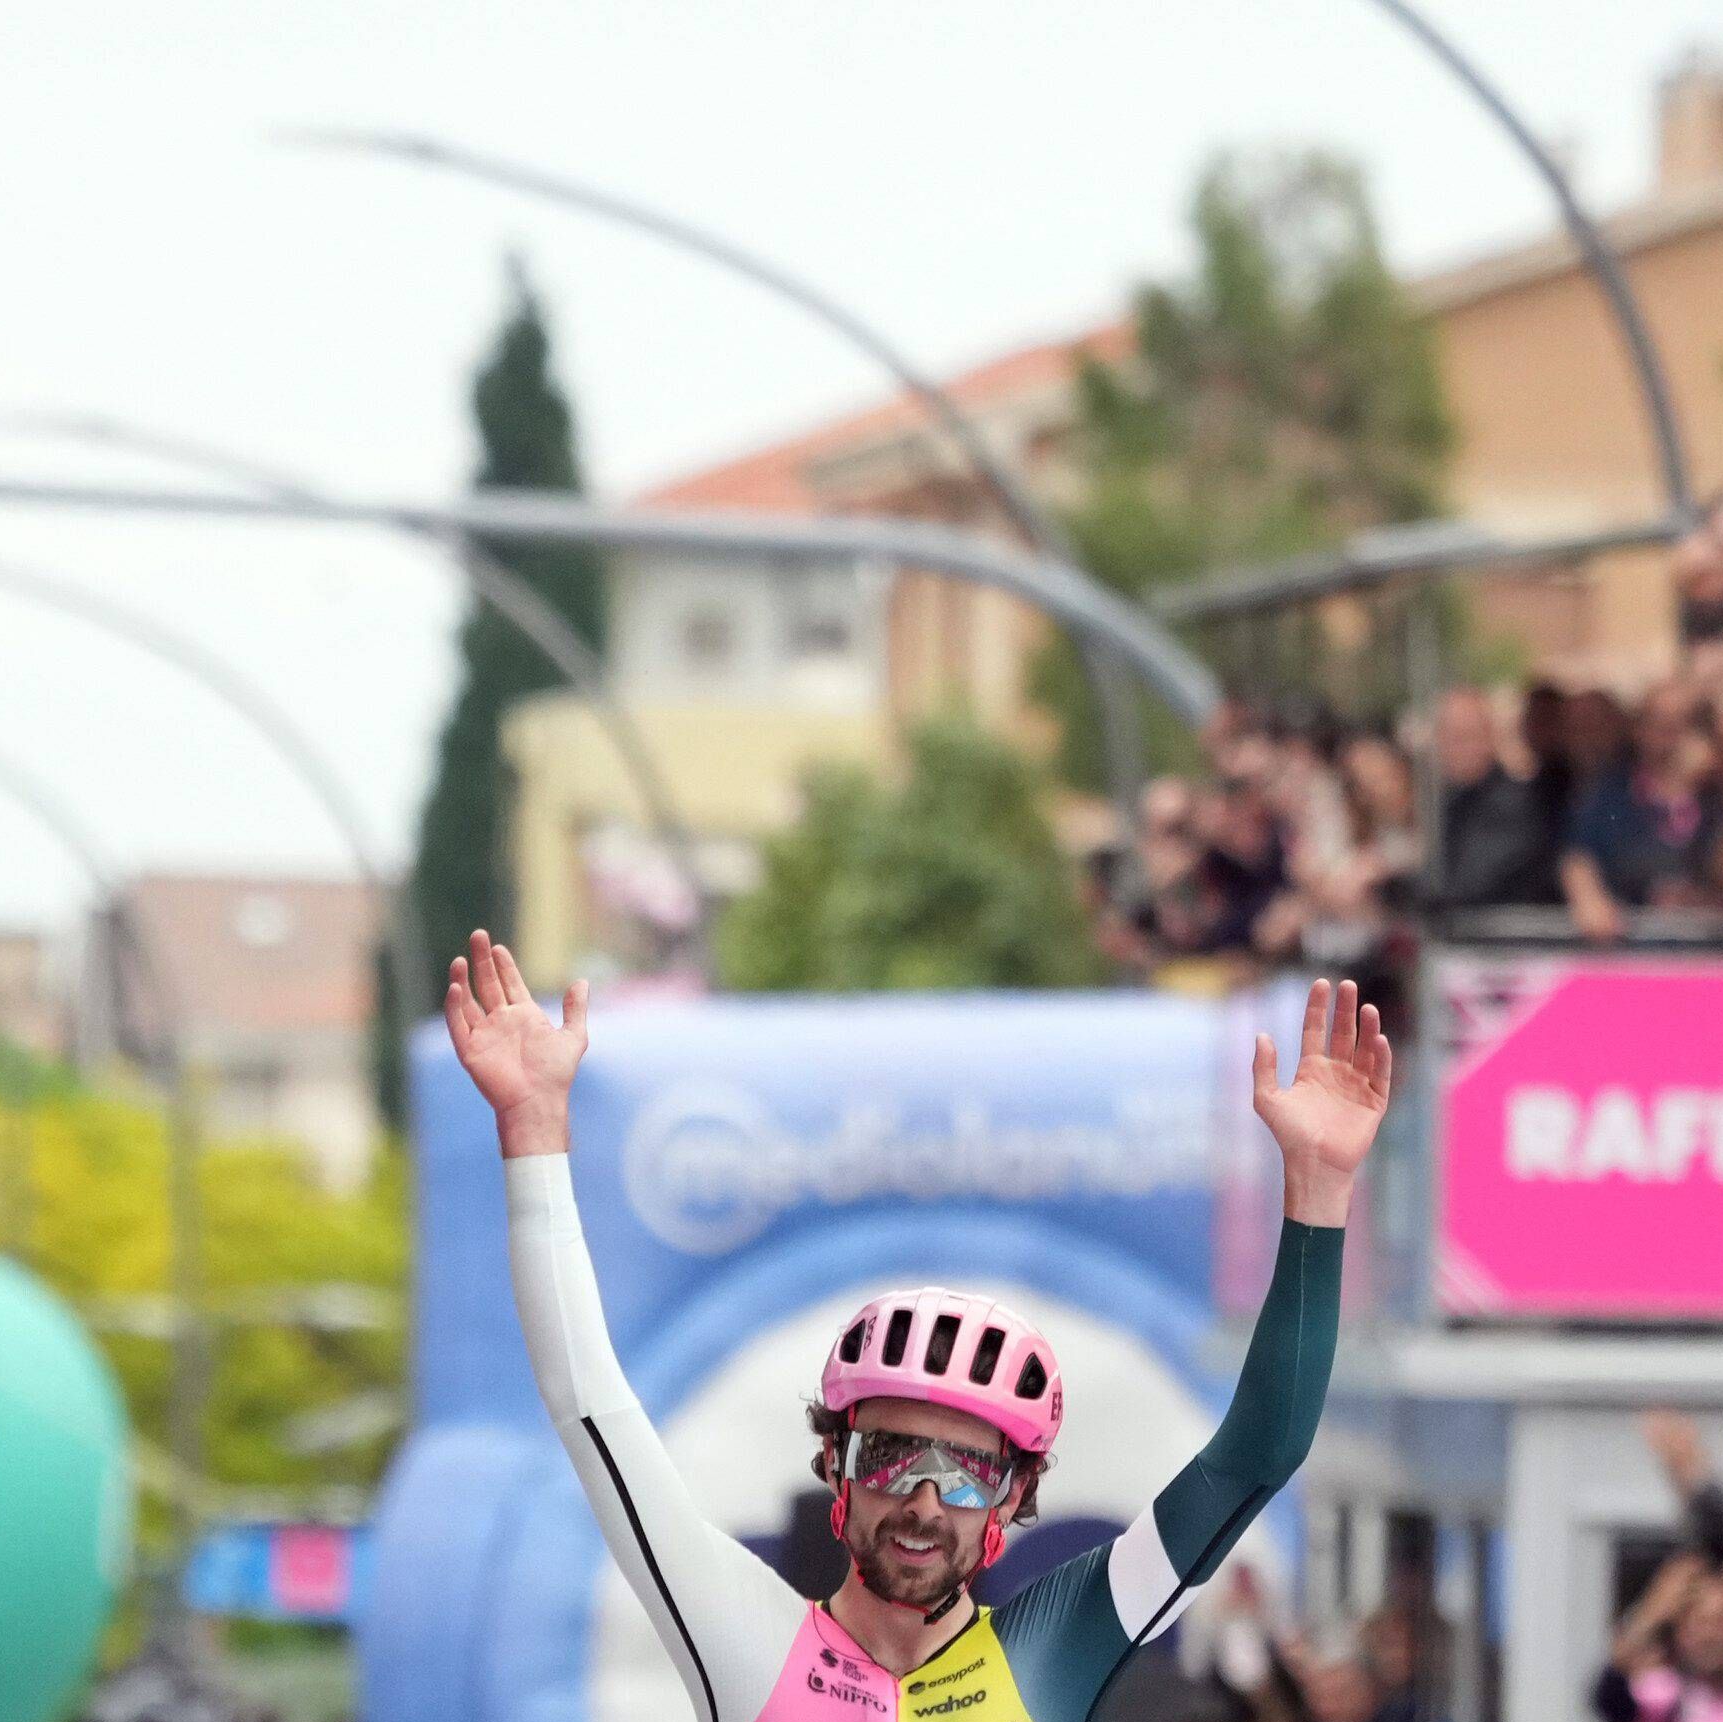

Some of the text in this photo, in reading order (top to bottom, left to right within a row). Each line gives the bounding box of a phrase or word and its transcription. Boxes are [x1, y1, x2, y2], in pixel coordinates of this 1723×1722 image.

[928, 1657, 986, 1688] easypost
[829, 1684, 887, 1713] NIPPO
[913, 1689, 987, 1718] wahoo
